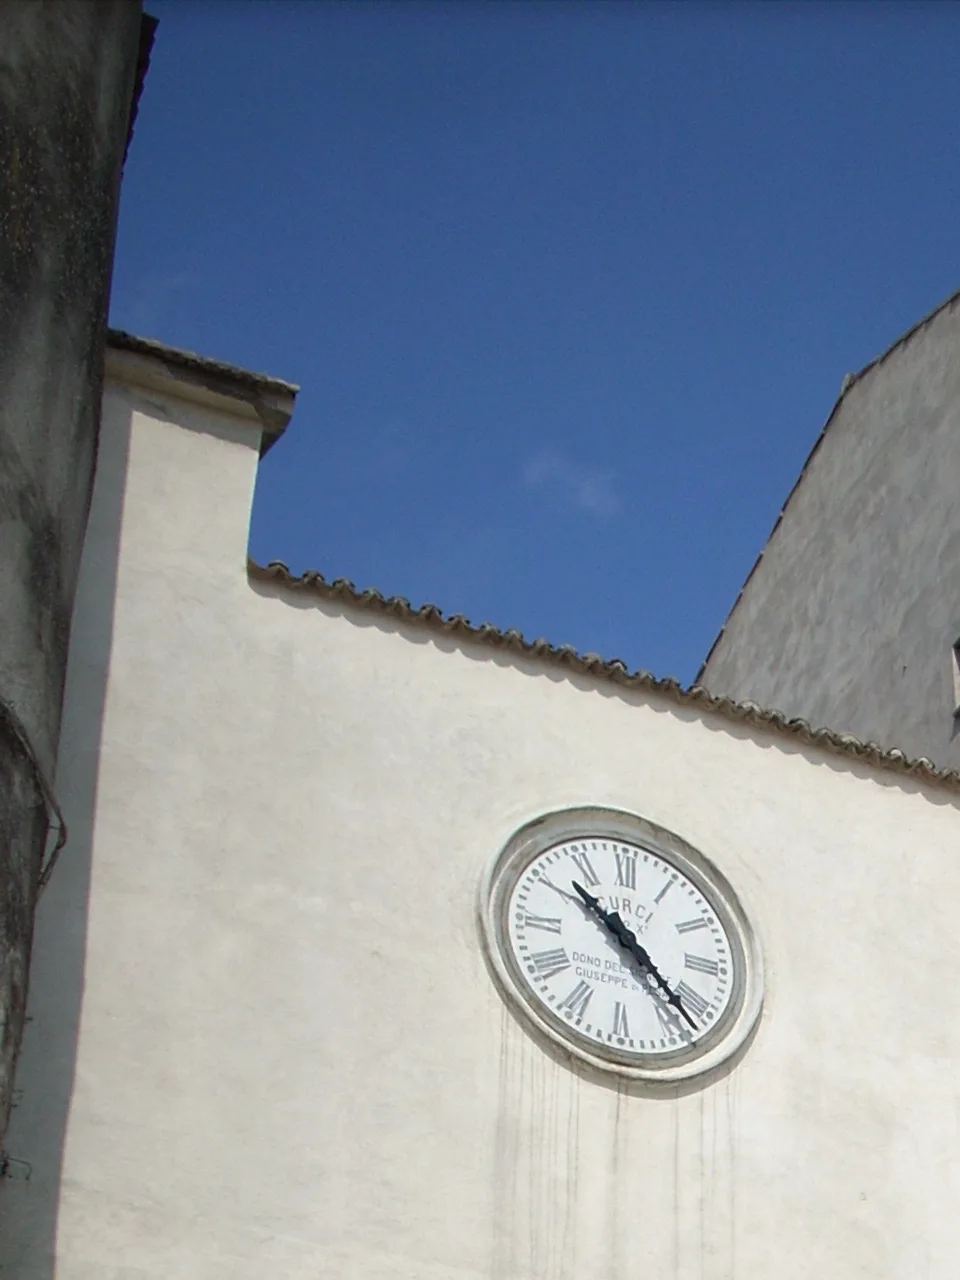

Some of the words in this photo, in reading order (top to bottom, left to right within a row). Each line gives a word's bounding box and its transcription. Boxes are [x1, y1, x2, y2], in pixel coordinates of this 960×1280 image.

[614, 853, 637, 891] XII
[524, 908, 563, 935] IX
[674, 916, 709, 935] II
[531, 947, 572, 981] VIII
[572, 951, 601, 968] DONO
[684, 951, 719, 977] III
[575, 966, 629, 989] GIUSEPPE
[563, 980, 595, 1018] VII
